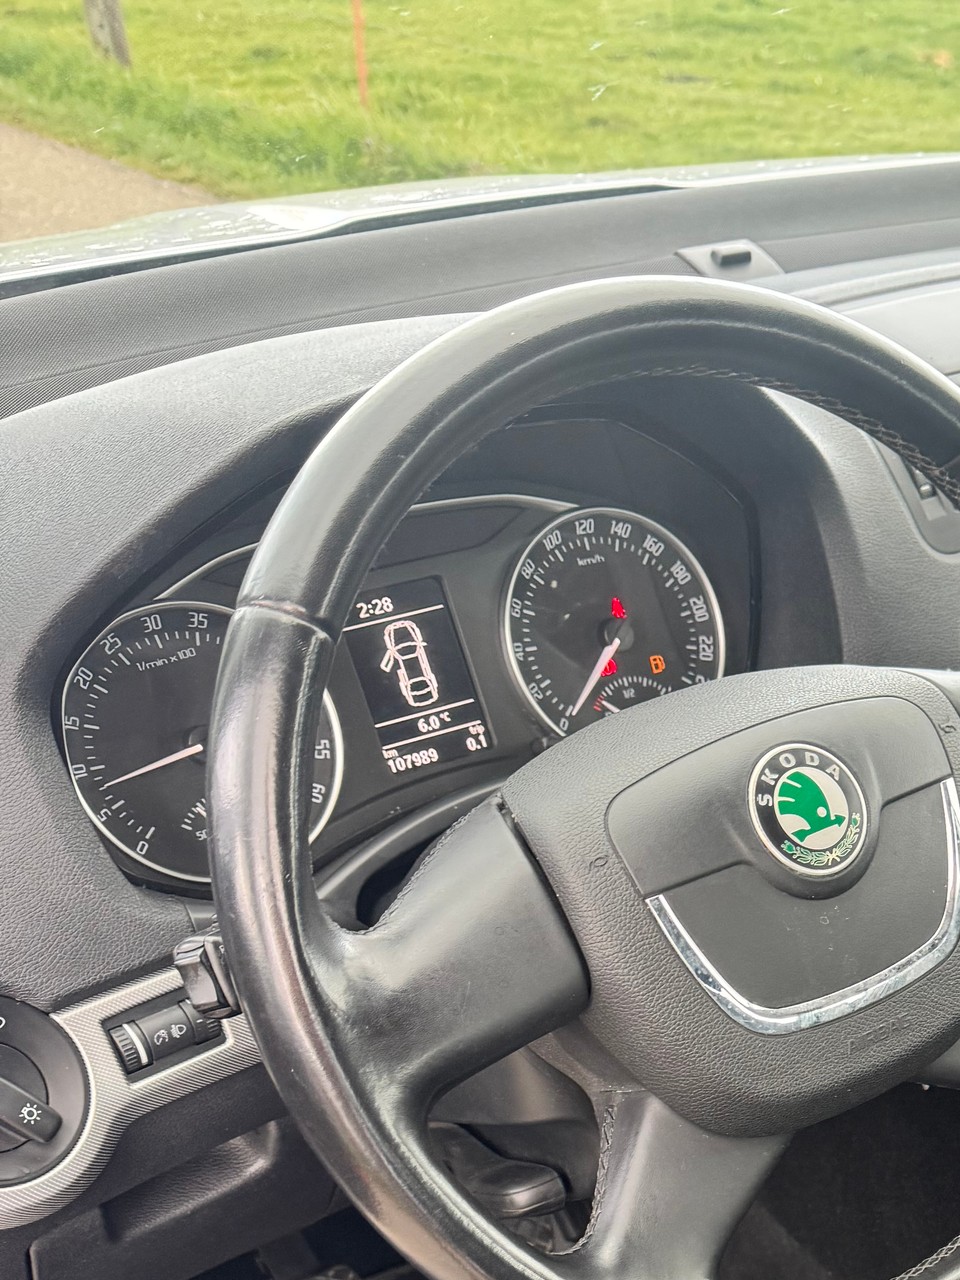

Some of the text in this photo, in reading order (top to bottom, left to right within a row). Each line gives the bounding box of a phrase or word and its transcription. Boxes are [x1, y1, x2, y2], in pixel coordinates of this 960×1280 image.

[574, 518, 595, 535] 120
[610, 520, 632, 539] 140
[542, 530, 563, 552] 100
[642, 534, 665, 557] 160
[520, 559, 536, 580] 80
[576, 555, 605, 567] km/h
[669, 560, 691, 585] 180
[356, 596, 394, 619] 2:28
[511, 598, 523, 618] 60
[688, 595, 709, 623] 200
[141, 614, 163, 633] 30
[187, 611, 208, 629] 35
[99, 632, 122, 656] 25
[514, 642, 525, 661] 40
[698, 635, 714, 662] 220
[73, 666, 94, 690] 20
[528, 683, 545, 702] 20
[622, 688, 636, 699] 1/2
[64, 716, 80, 731] 15
[559, 717, 569, 731] 0
[314, 739, 331, 760] 55
[465, 734, 489, 752] 0.1
[382, 749, 399, 760] km
[387, 748, 439, 774] 107989
[71, 763, 89, 780] 10
[97, 808, 112, 822] 5
[136, 840, 149, 855] 0
